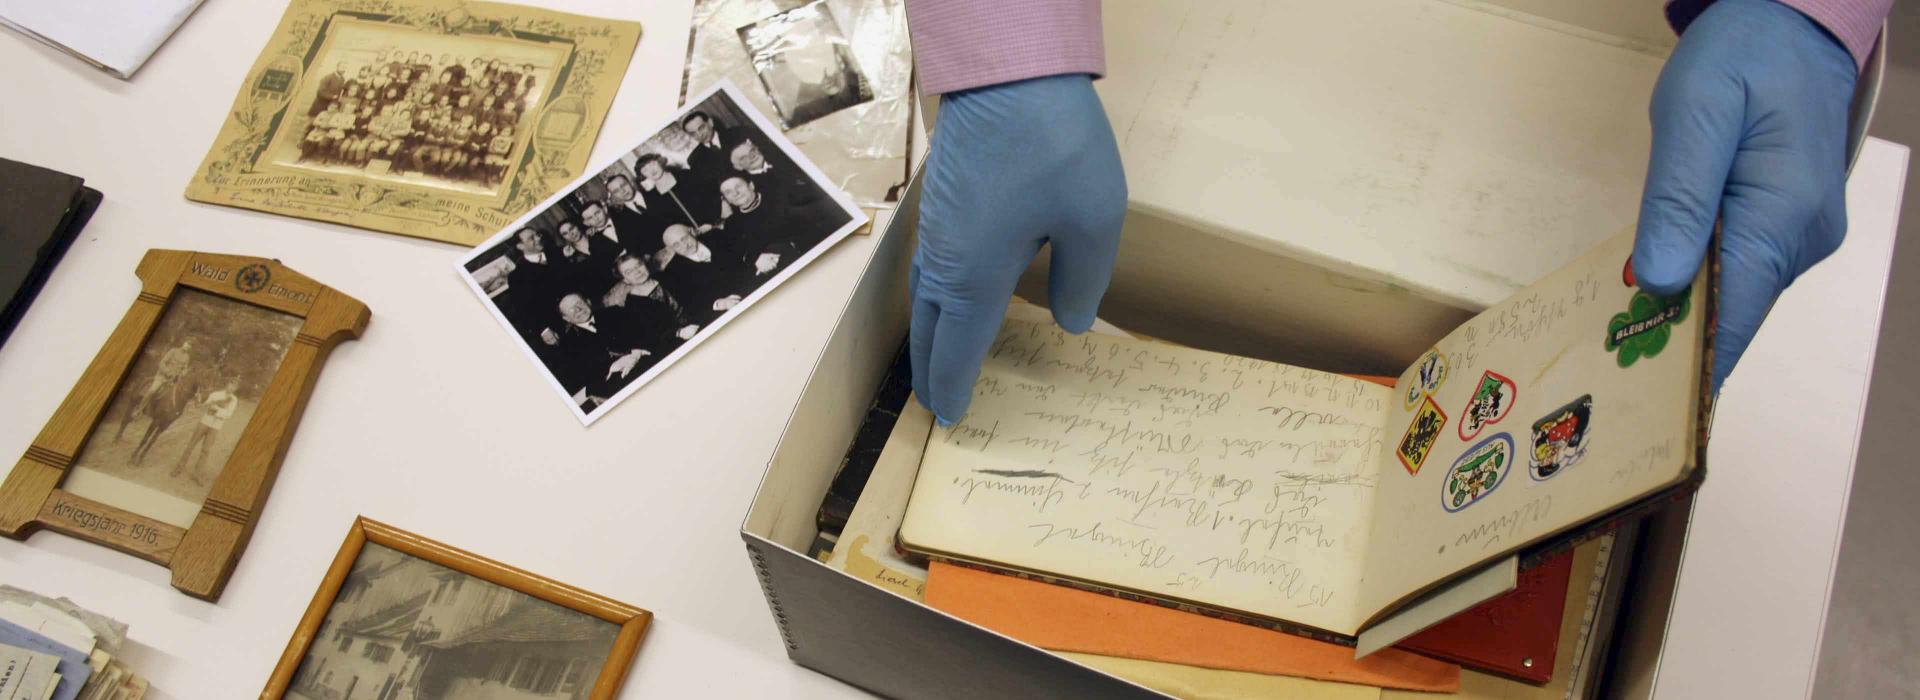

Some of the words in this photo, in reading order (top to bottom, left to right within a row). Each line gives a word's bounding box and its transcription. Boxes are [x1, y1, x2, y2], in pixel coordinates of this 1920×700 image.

[233, 174, 296, 187] Erinnerung
[298, 176, 311, 187] an
[435, 198, 471, 213] meine
[191, 261, 231, 283] Wald
[1615, 322, 1644, 341] BLEIB
[1645, 312, 1665, 330] MIR
[52, 499, 127, 535] Kriegsjahr
